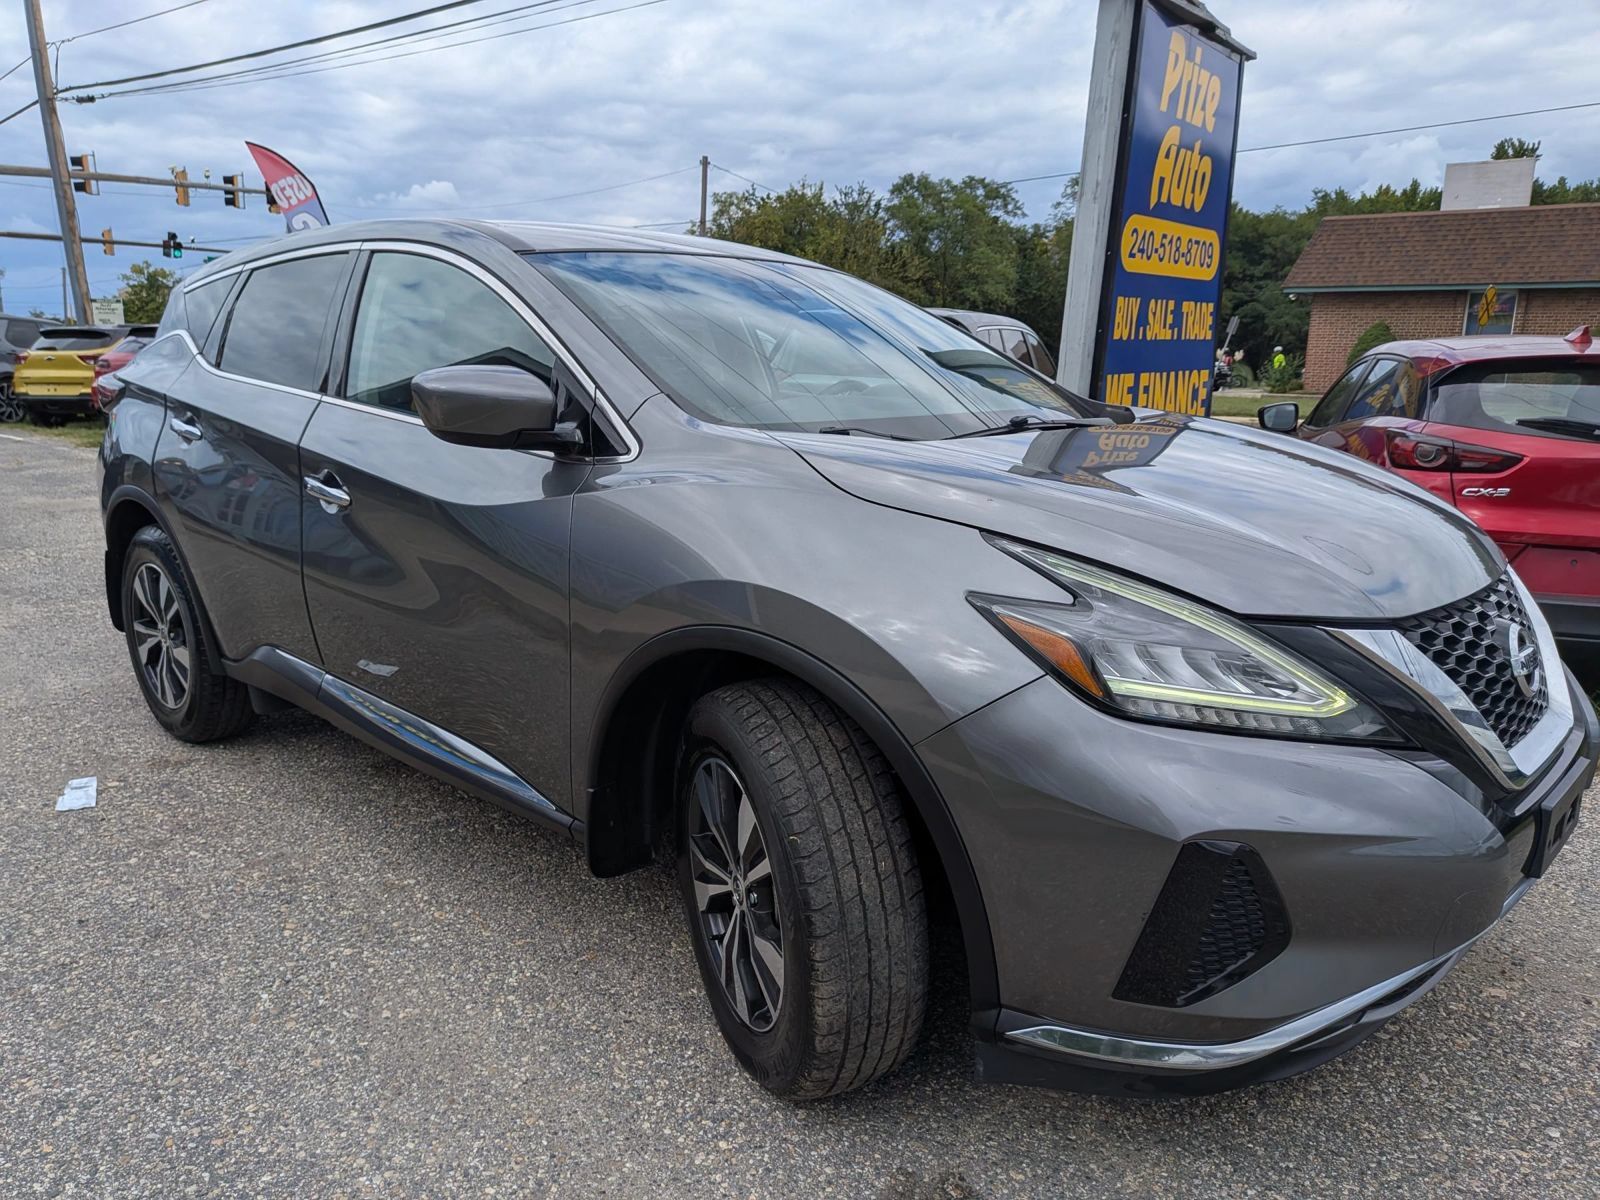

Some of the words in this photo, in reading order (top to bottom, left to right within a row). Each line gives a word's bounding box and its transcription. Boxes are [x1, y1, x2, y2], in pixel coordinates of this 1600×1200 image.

[1160, 32, 1220, 132] Prize
[1150, 126, 1212, 212] Auto
[1128, 229, 1214, 268] 240-518-8709
[1113, 297, 1140, 340] BUY
[1181, 301, 1215, 340] TRADE
[1138, 369, 1210, 416] FINANCE
[1461, 487, 1511, 497] CX-3
